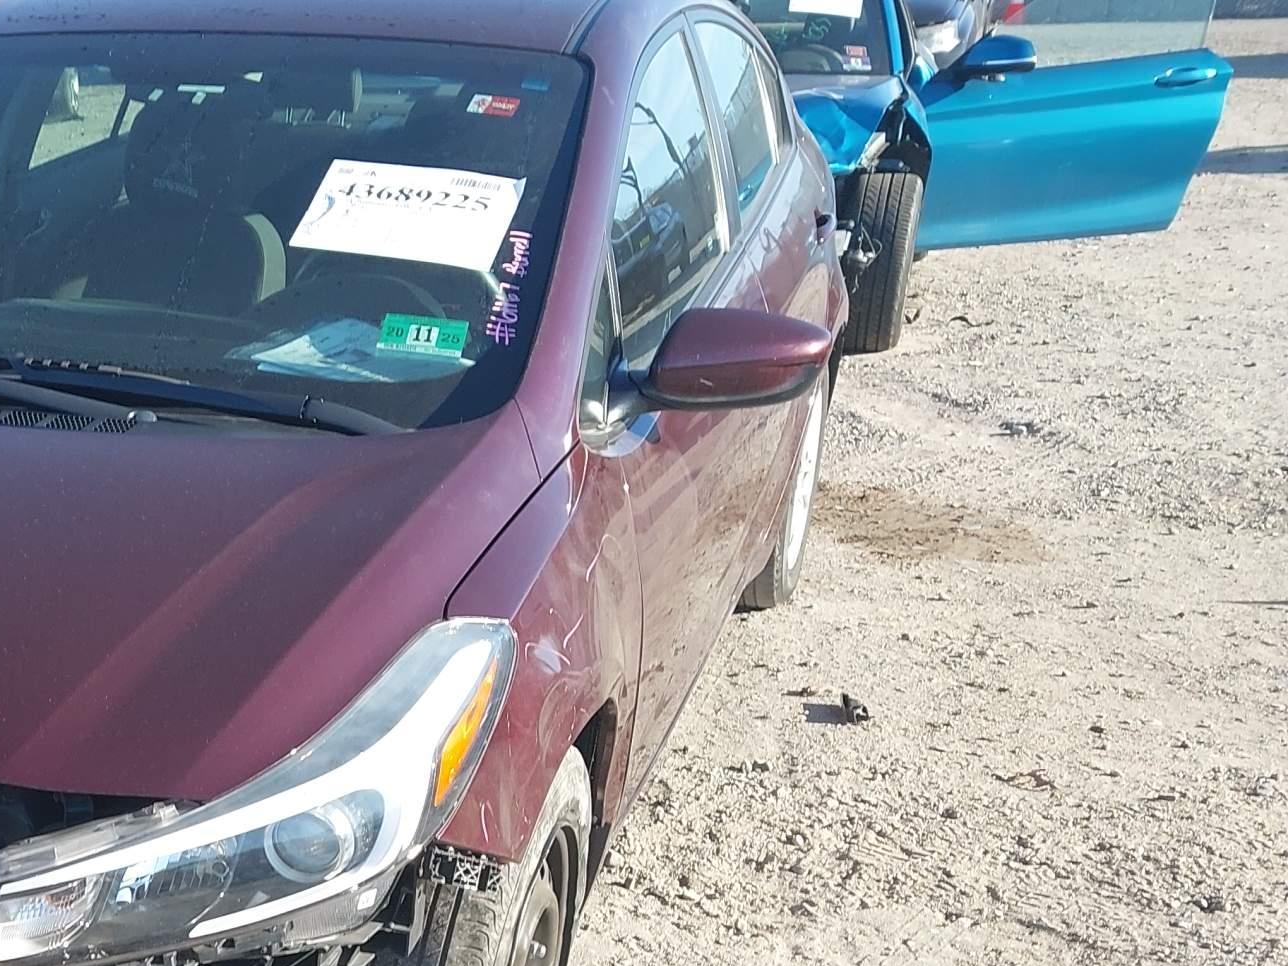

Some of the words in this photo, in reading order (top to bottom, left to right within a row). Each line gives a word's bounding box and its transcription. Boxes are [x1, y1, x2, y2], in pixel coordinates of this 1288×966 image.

[338, 182, 491, 212] 43689225
[385, 326, 404, 338] 20
[412, 326, 433, 343] 11
[441, 332, 460, 344] 25
